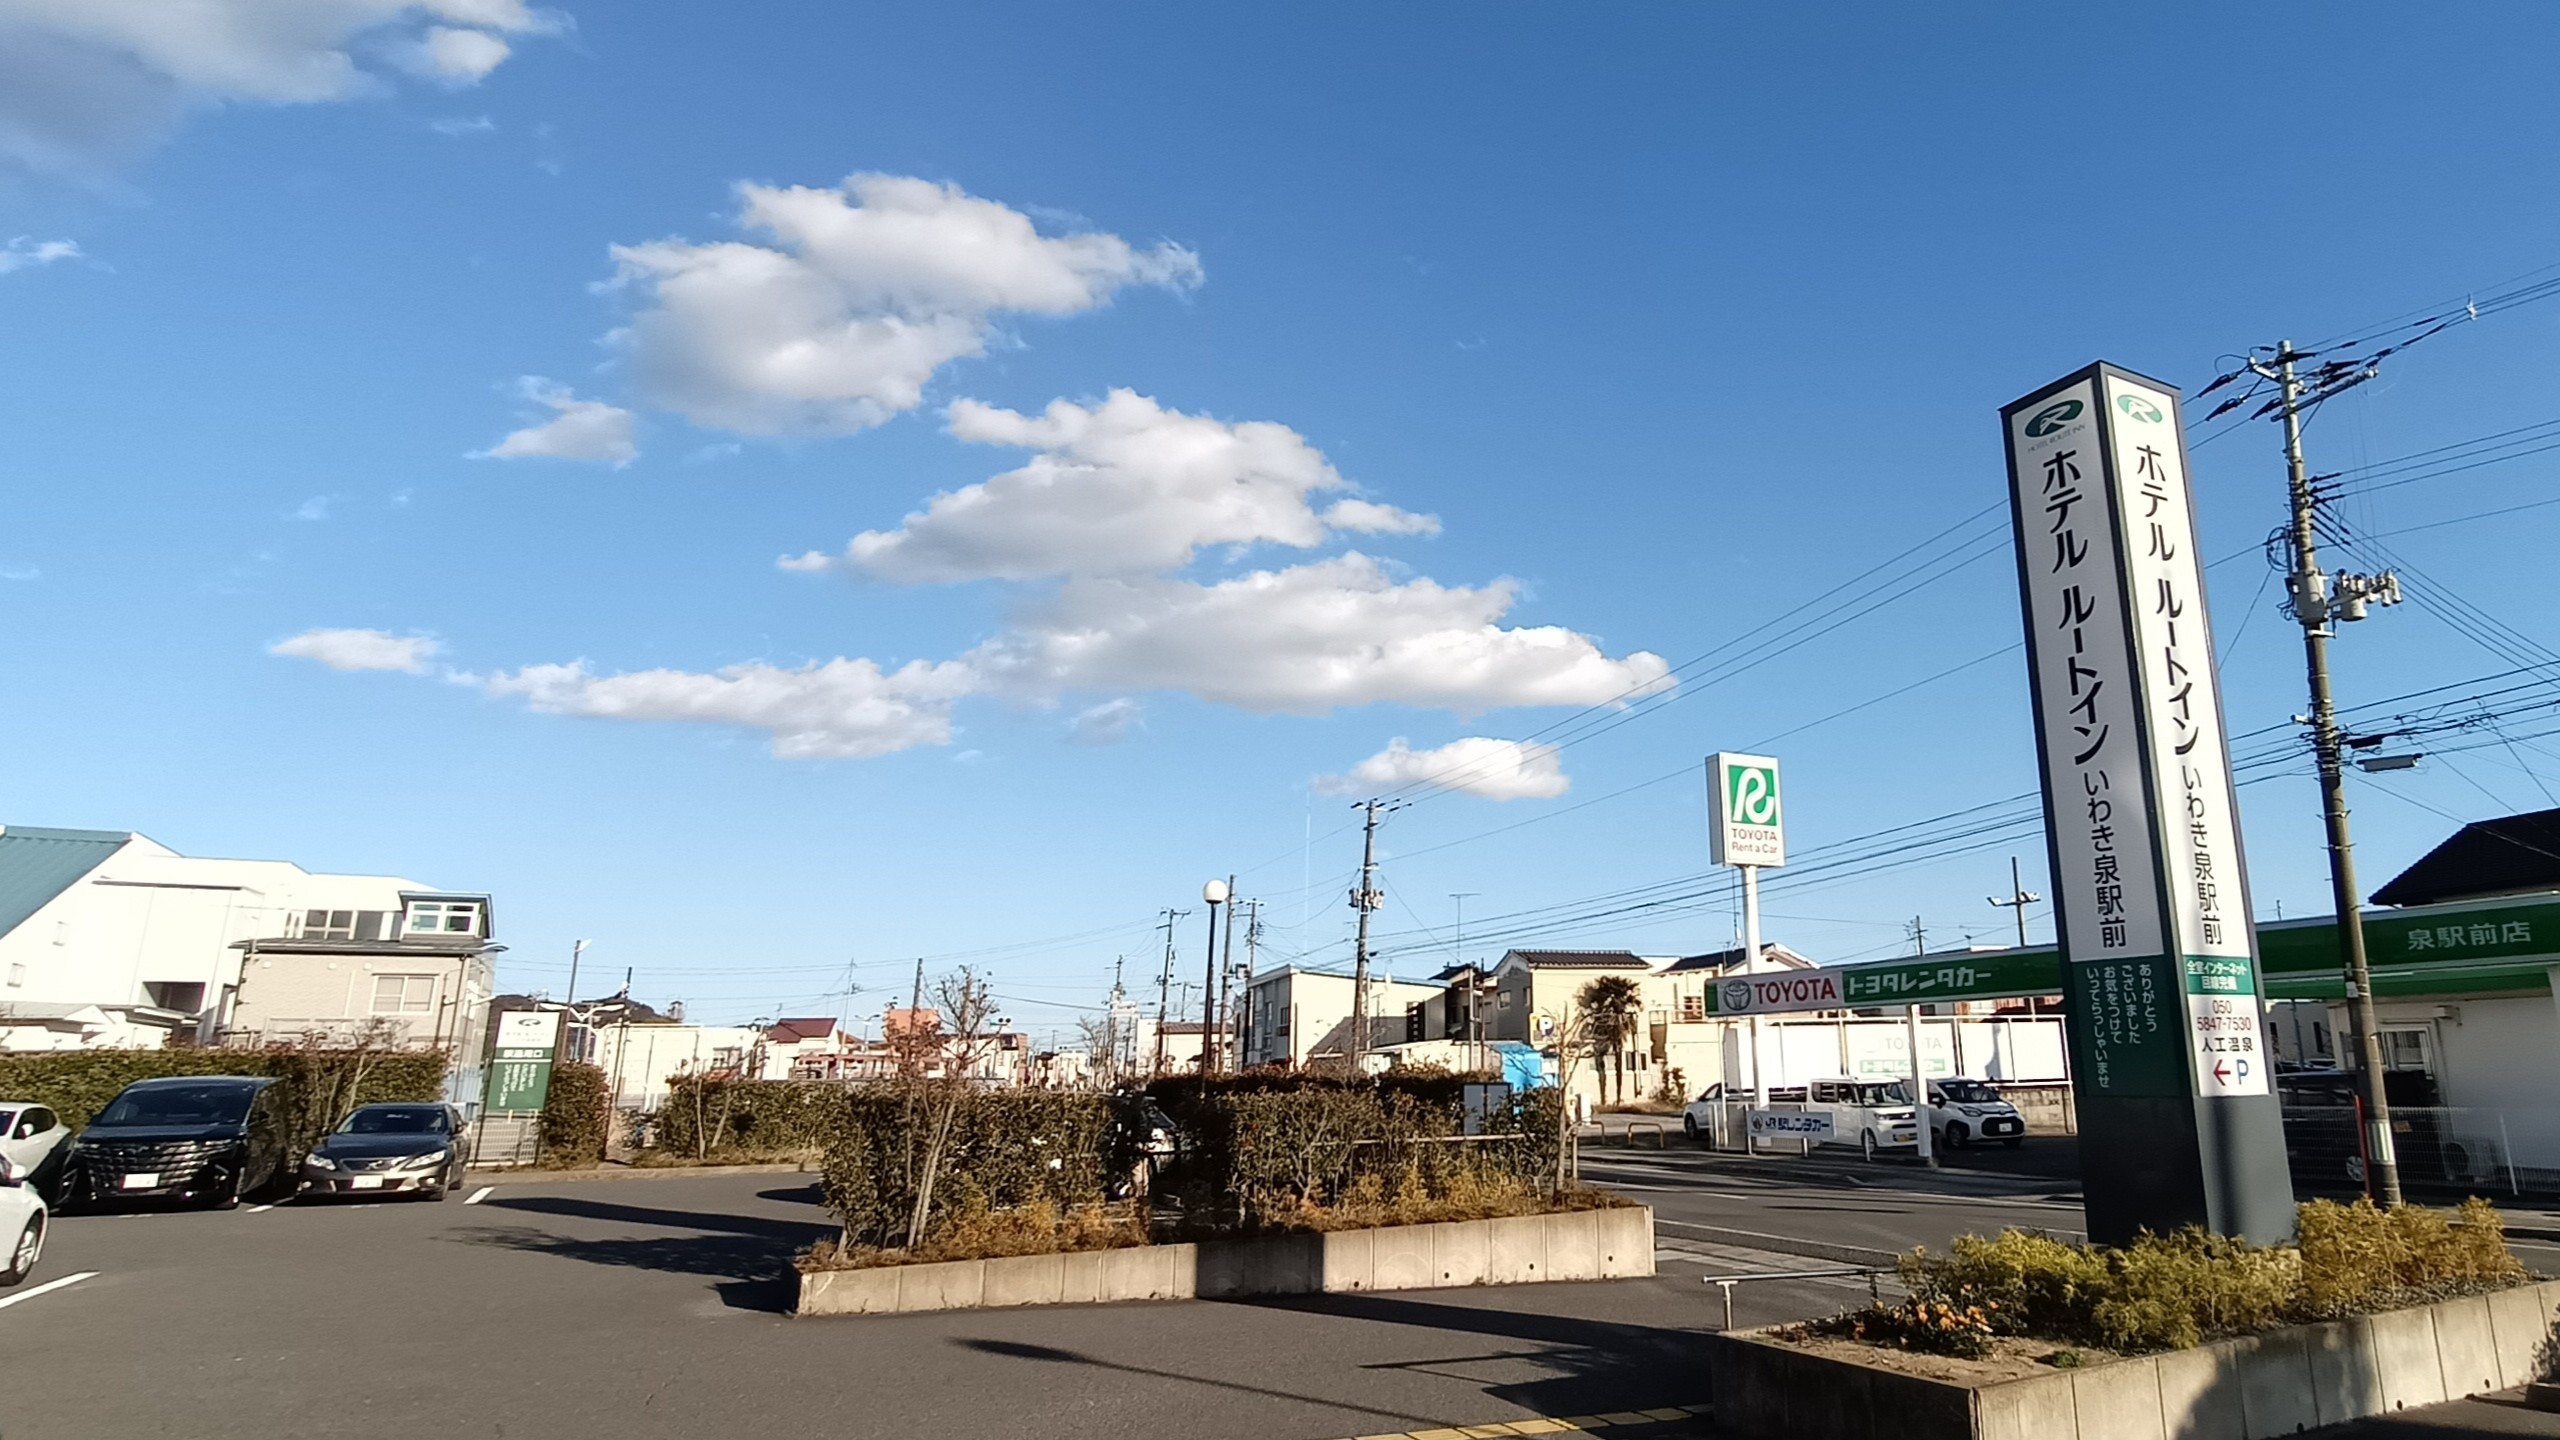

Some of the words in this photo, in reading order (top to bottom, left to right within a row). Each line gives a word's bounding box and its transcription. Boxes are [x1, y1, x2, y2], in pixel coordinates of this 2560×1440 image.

[2042, 450, 2088, 574] ホテル
[2059, 585, 2109, 765] ルートイン
[2136, 445, 2175, 562] ホテル
[2156, 578, 2199, 755] ルートイン
[2182, 765, 2222, 945] いわき泉駅前
[1731, 828, 1777, 841] TOYOTA
[1732, 841, 1753, 852] Rent
[1762, 843, 1778, 854] Car
[2083, 769, 2127, 949] いわき泉駅前
[2407, 920, 2532, 950] 泉駅前店
[1754, 977, 1837, 1004] TOYOTA
[1849, 966, 1992, 996] トヨタレンタカー
[2103, 966, 2122, 1044] お気をつけて
[2121, 965, 2141, 1044] ございました
[2139, 964, 2157, 1032] ありがとう
[2212, 1000, 2233, 1014] 050
[2086, 967, 2110, 1088] いってらっしゃいませ
[2196, 1017, 2252, 1031] 5847-7530
[2202, 1037, 2253, 1052] 人工温泉
[2236, 1059, 2249, 1085] P
